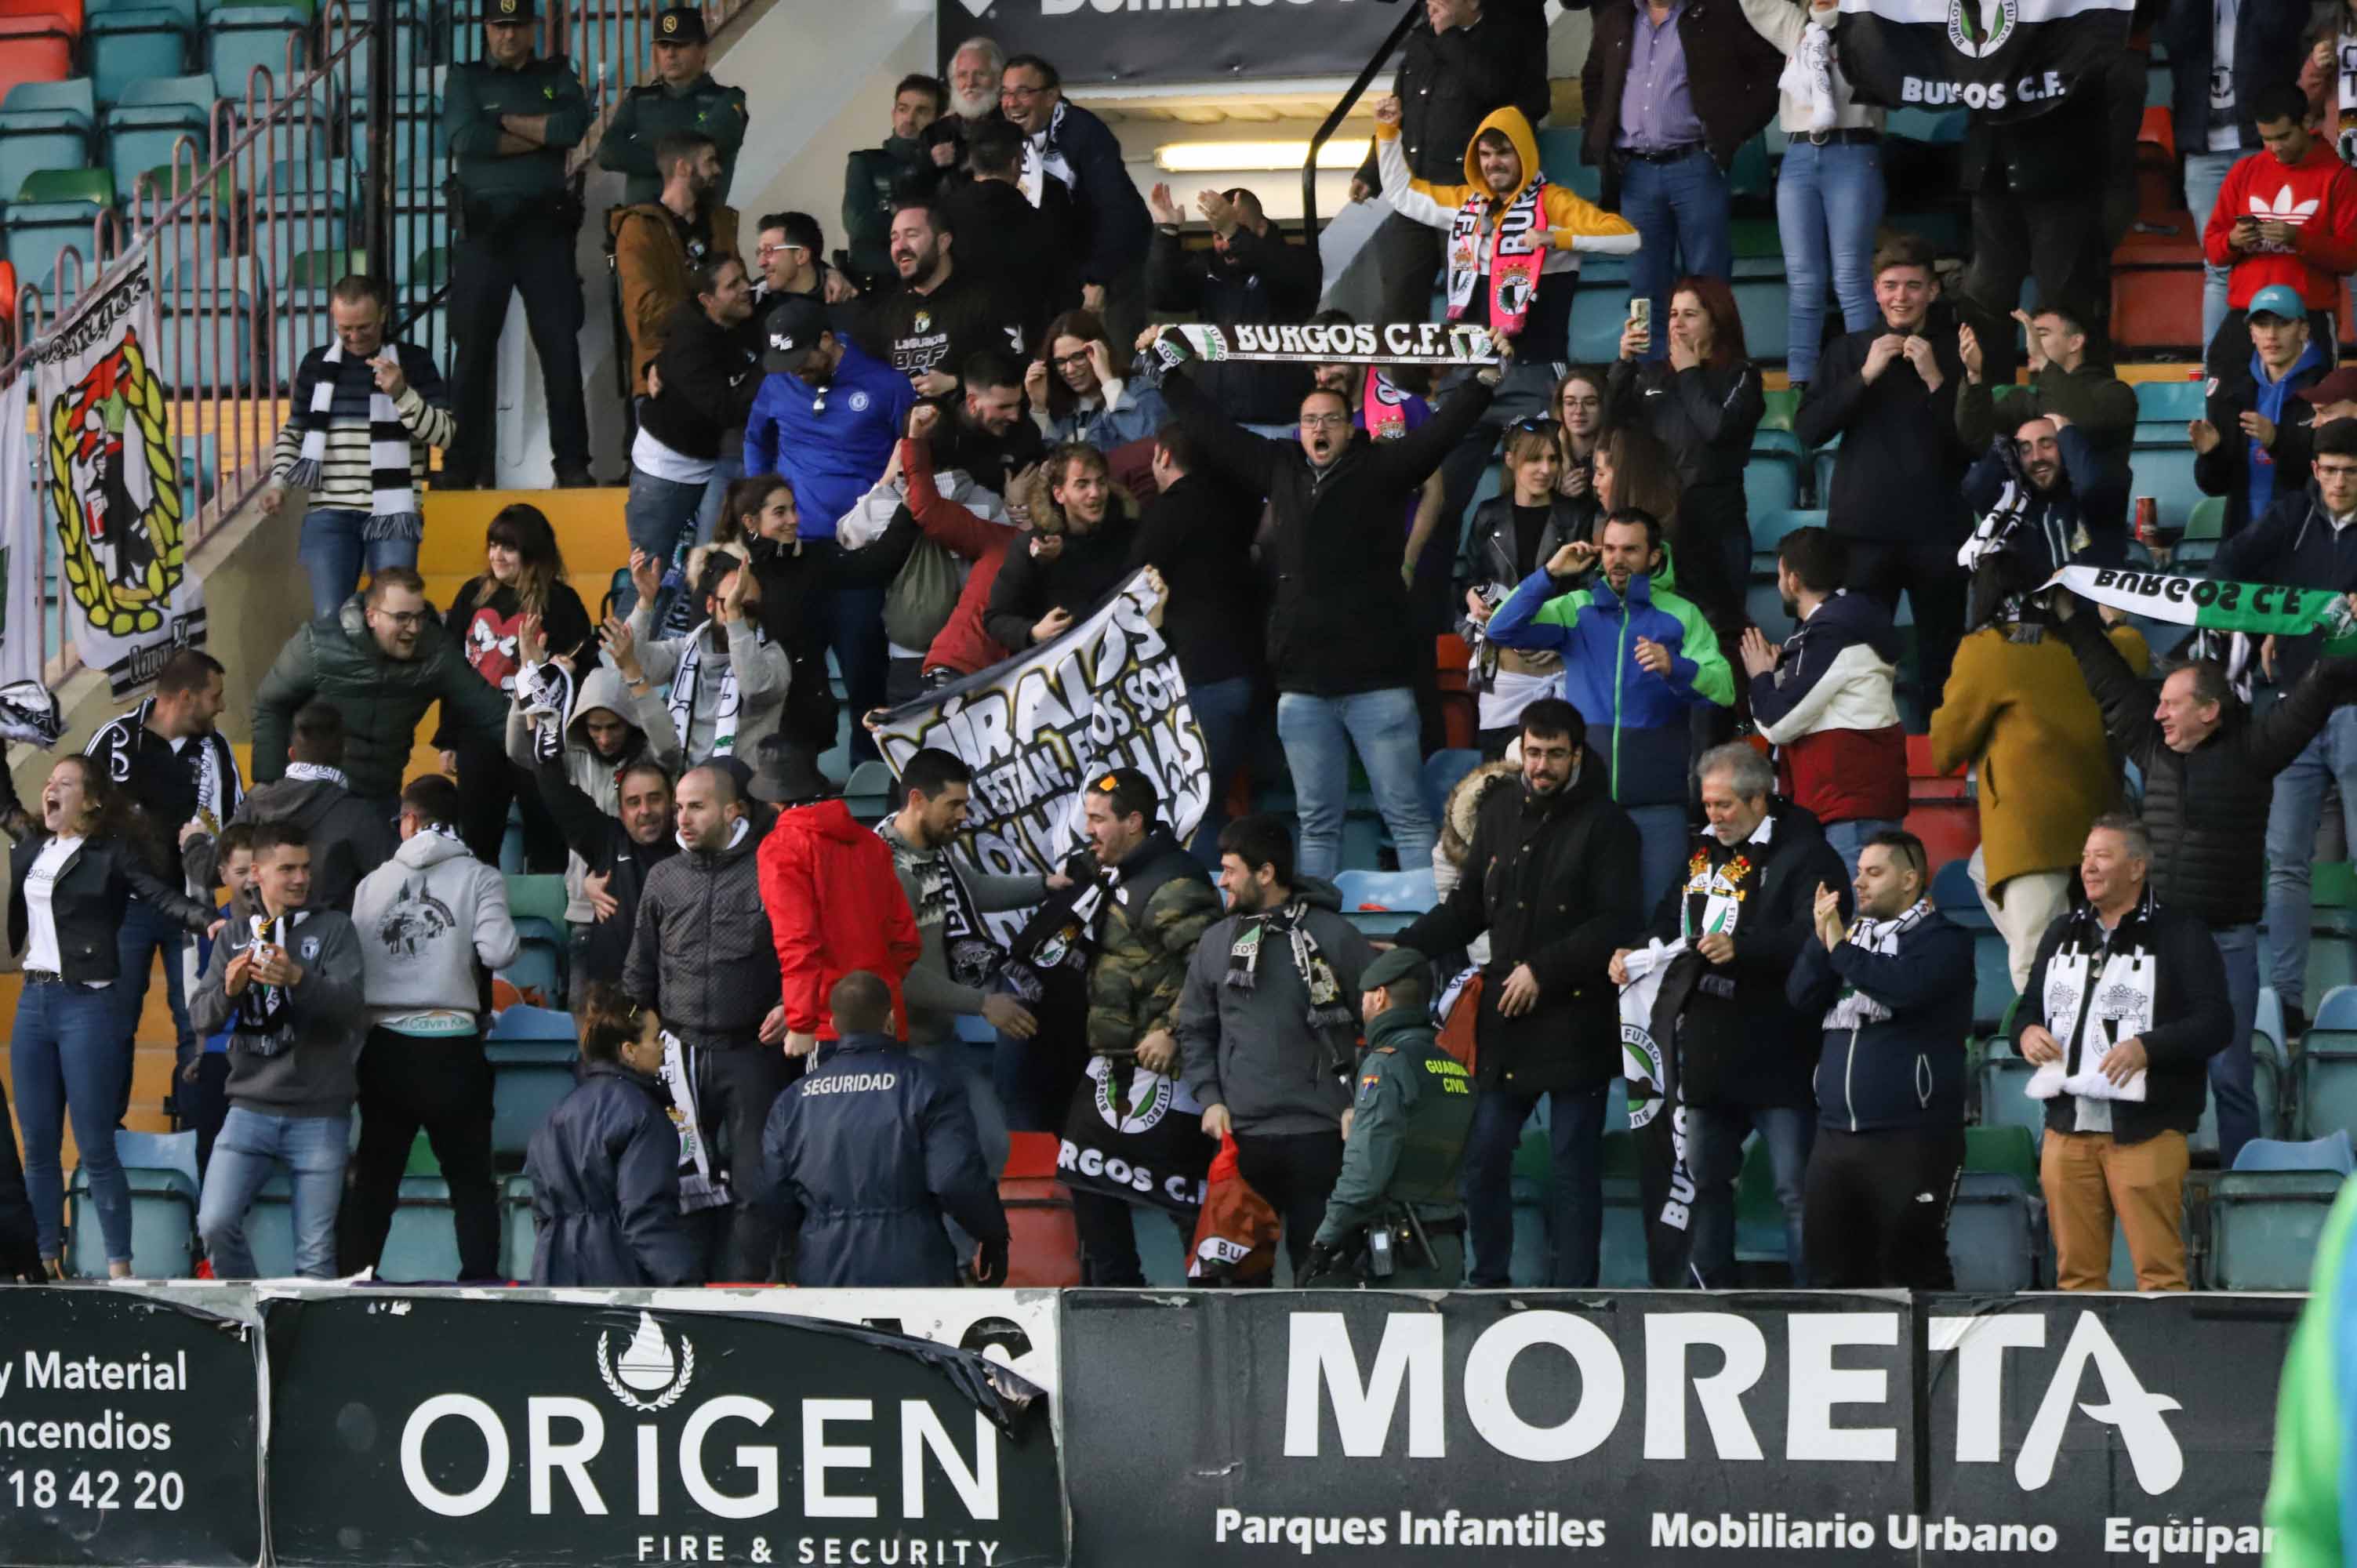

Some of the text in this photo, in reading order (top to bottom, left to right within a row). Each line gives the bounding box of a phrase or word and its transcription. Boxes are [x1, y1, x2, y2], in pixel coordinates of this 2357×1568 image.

[892, 344, 949, 370] BCF
[1233, 323, 1446, 356] BURGOS C.F.
[801, 1073, 896, 1097] SEGURIDAD
[1443, 1077, 1469, 1094] CIVIL
[1139, 1083, 1170, 1128] FUTBOL
[25, 1349, 187, 1391] Material
[1283, 1309, 2184, 1495] MORETA
[8, 1468, 185, 1512] 18 42 20
[1215, 1508, 1387, 1556] Parques
[1400, 1510, 1606, 1548] Infantiles
[1651, 1512, 1876, 1550] Mobiliario
[1887, 1515, 2058, 1553] Urbano
[637, 1535, 1001, 1567] FIRE & SECURITY
